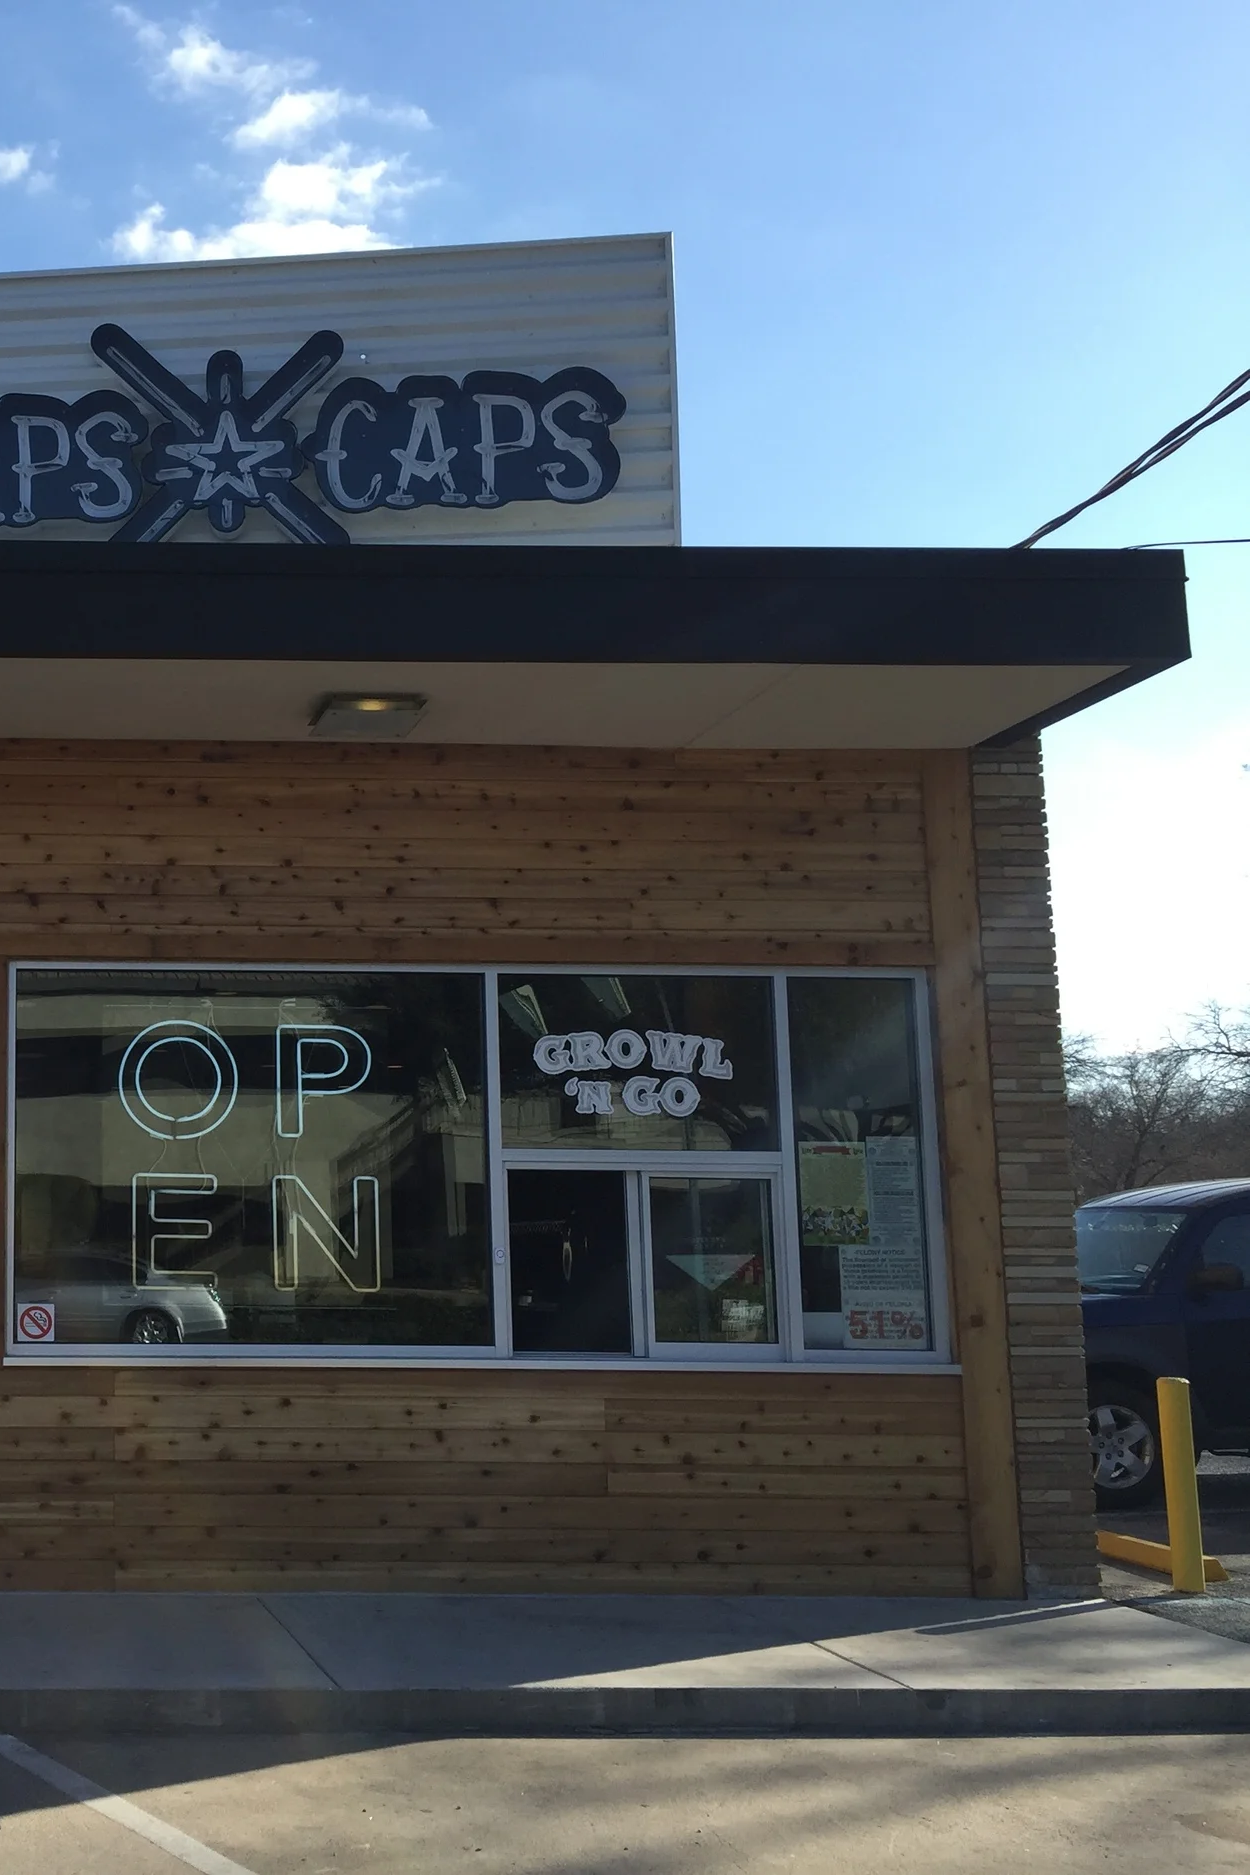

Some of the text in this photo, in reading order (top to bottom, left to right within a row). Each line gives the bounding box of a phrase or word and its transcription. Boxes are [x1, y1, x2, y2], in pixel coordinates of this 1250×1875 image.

[314, 389, 609, 508] CAPS
[533, 1029, 734, 1080] GROWL
[621, 1076, 701, 1117] GO
[848, 1310, 924, 1339] 51%
